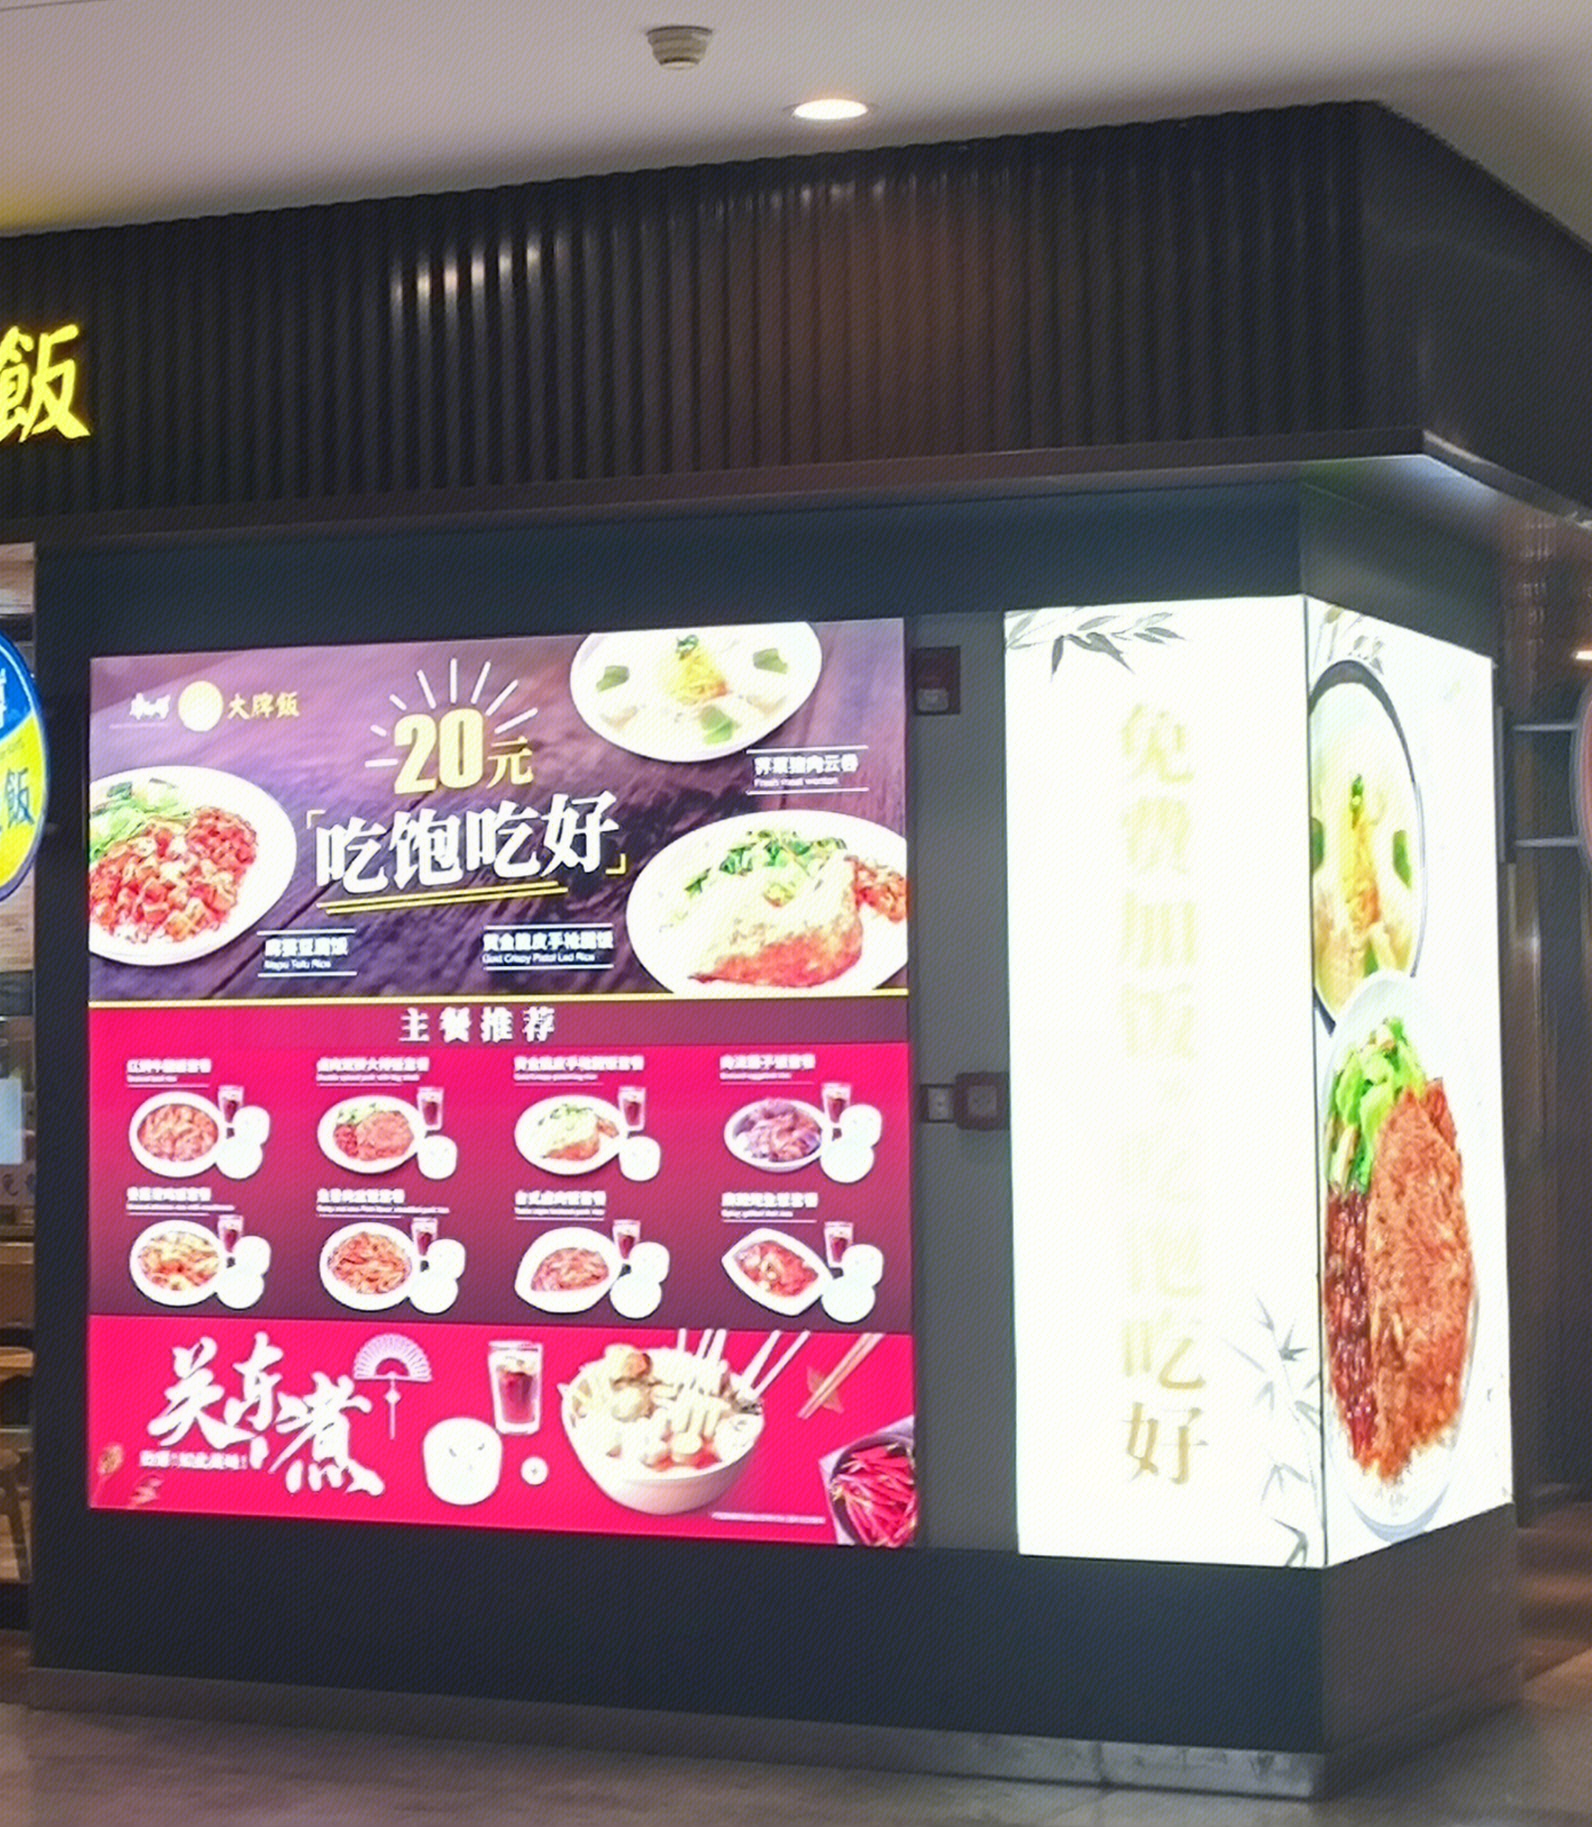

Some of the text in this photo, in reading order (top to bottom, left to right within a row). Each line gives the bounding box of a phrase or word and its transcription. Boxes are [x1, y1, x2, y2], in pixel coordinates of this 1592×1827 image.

[394, 708, 534, 794] 20元
[398, 1006, 555, 1043] 主餐推荐
